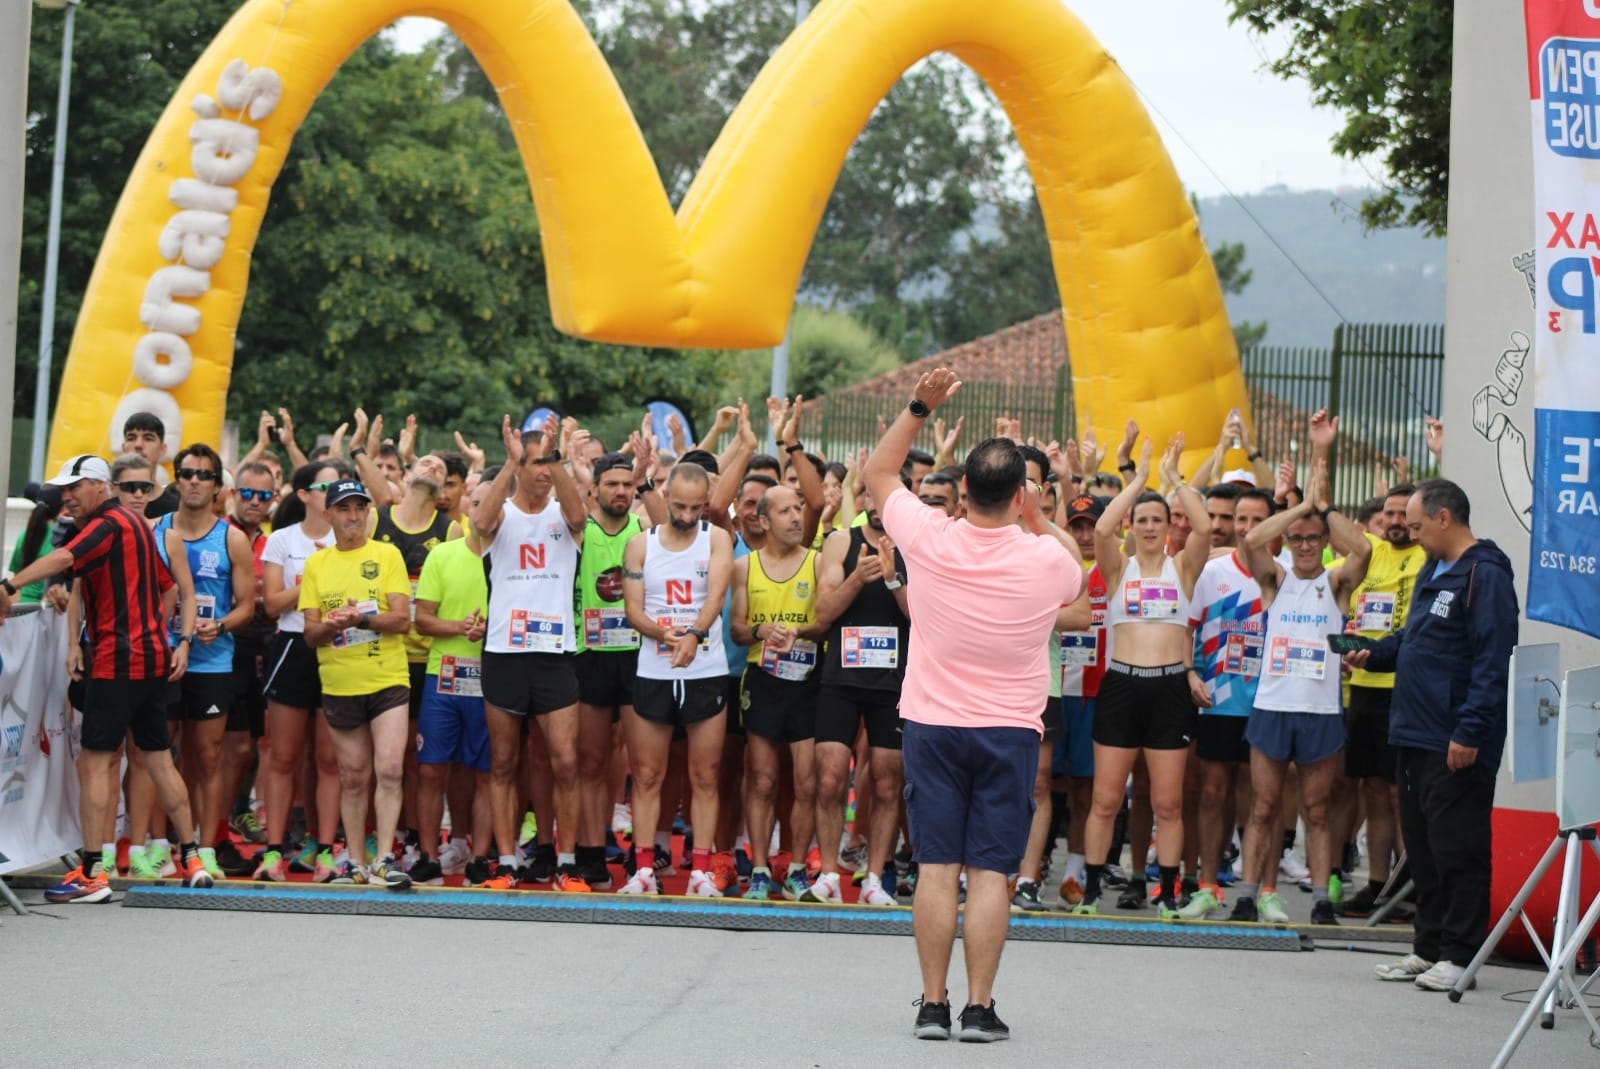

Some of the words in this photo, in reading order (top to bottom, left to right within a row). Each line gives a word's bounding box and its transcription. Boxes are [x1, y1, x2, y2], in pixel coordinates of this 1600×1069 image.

[519, 543, 545, 570] N
[666, 580, 692, 606] N
[539, 621, 553, 633] 60
[616, 617, 623, 627] 7
[869, 637, 888, 648] 173
[1075, 636, 1083, 646] 3
[788, 651, 807, 662] 175
[1300, 648, 1314, 659] 90
[1132, 666, 1163, 678] PUMA
